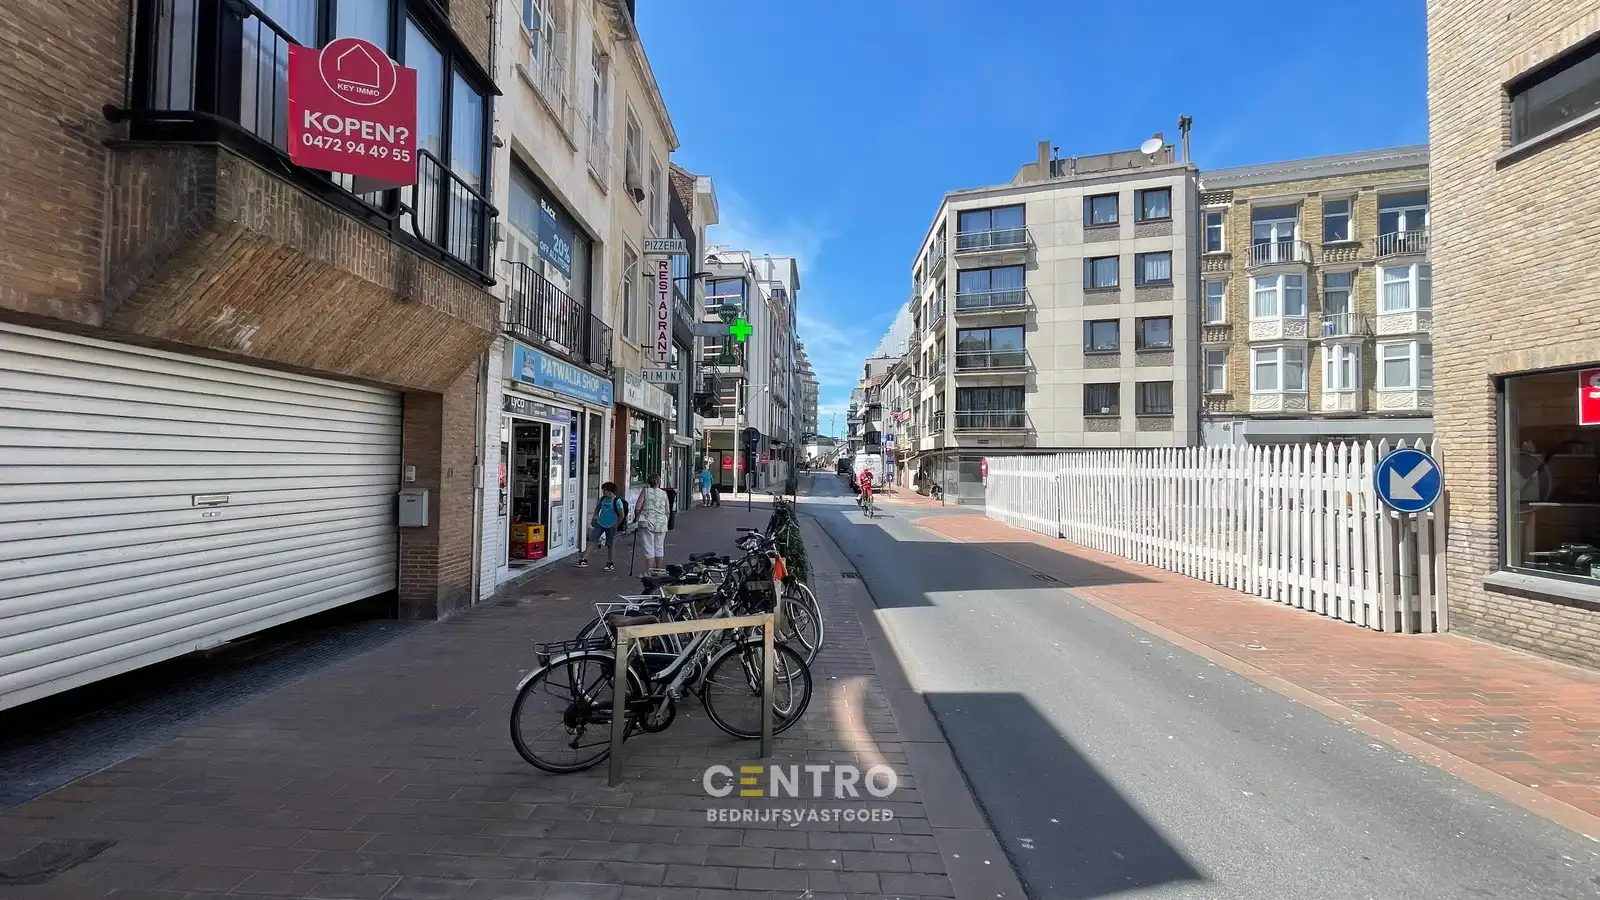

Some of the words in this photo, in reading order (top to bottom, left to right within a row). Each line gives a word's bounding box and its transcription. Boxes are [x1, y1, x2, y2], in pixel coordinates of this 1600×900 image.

[337, 83, 355, 93] KEY
[356, 87, 380, 97] IMMO
[304, 109, 409, 145] KOPEN?
[302, 133, 342, 152] 0472
[346, 141, 365, 155] 94
[369, 145, 388, 159] 49
[392, 149, 410, 162] 55
[553, 234, 571, 264] 20%
[644, 240, 683, 250] PIZZERIA
[658, 261, 668, 361] RESTAURANT
[541, 356, 581, 386] PATWALIA
[582, 373, 600, 393] SHOP
[642, 371, 681, 381] RIMINI
